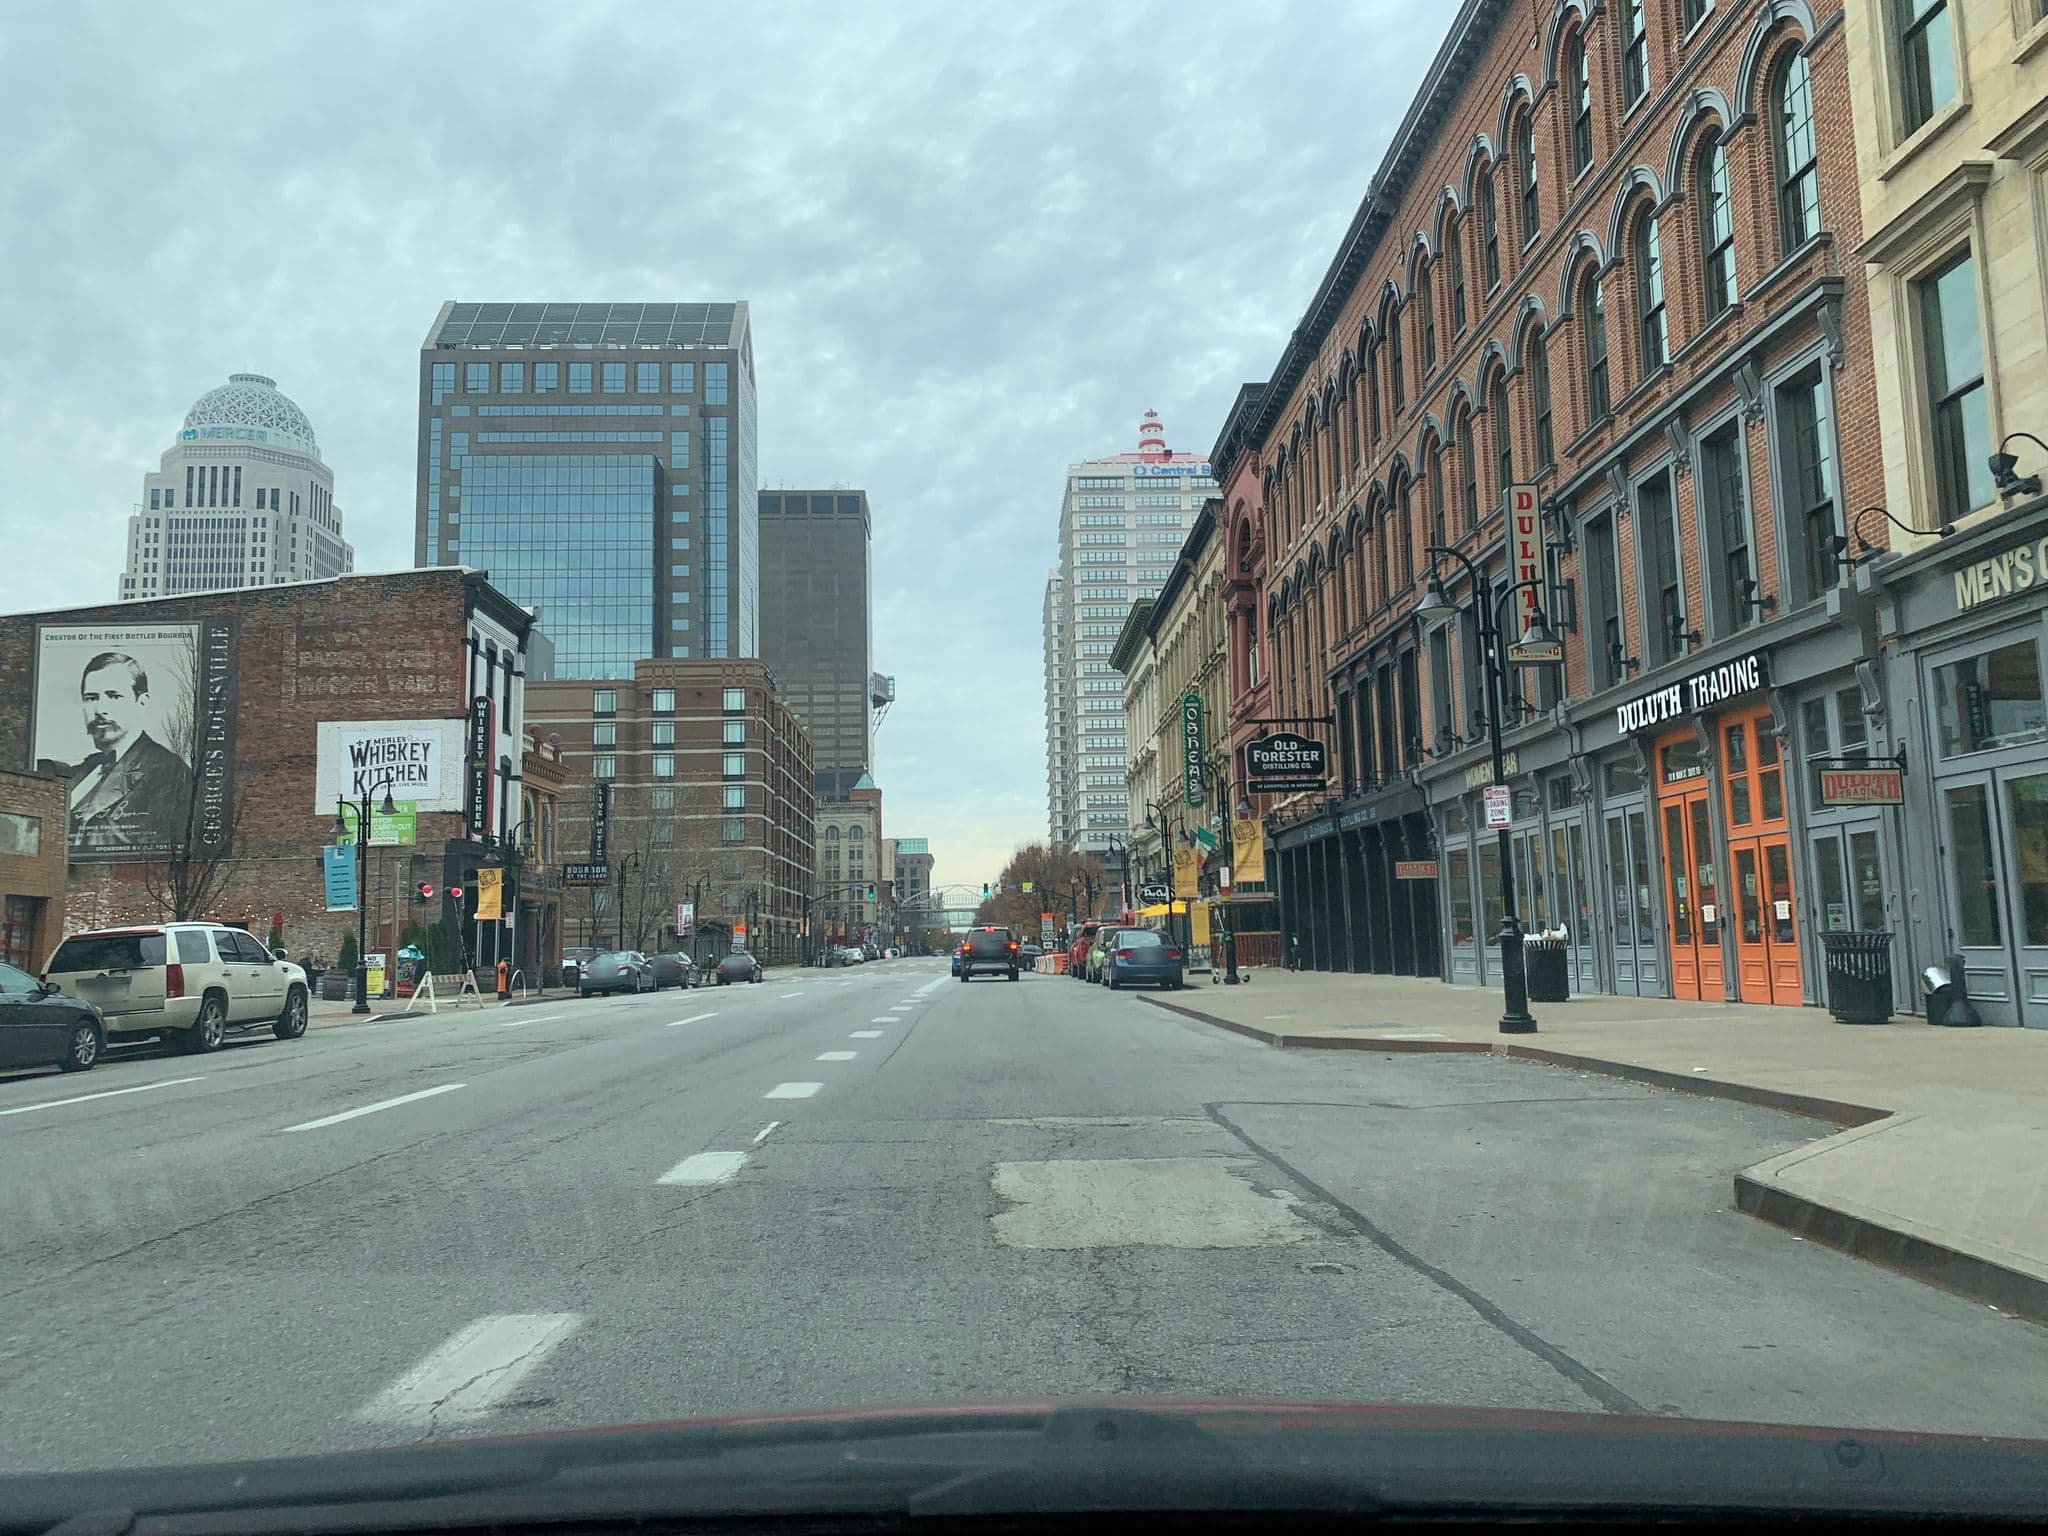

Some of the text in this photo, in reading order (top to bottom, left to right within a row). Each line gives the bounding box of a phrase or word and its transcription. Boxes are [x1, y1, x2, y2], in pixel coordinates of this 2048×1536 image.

[1151, 465, 1197, 475] Central
[1516, 492, 1537, 634] DULUT
[1954, 546, 2034, 610] MEN'S
[104, 632, 124, 640] FIRST
[157, 631, 193, 639] BOURBON
[1616, 655, 1760, 734] DULUTH TRADING
[349, 739, 431, 768] WHISKEY
[1253, 749, 1319, 762] FORESTER
[1273, 740, 1298, 751] OLD
[474, 702, 487, 828] WHISKEY KITCHEN
[1262, 762, 1300, 770] DISTILLING
[1502, 752, 1518, 777] EAR
[353, 764, 428, 795] KITCHEN
[1824, 773, 1901, 800] DULUTH
[202, 750, 225, 844] GEORGE'S
[1490, 808, 1506, 817] ZONE
[596, 821, 605, 856] MUSIC
[1042, 932, 1054, 940] 150
